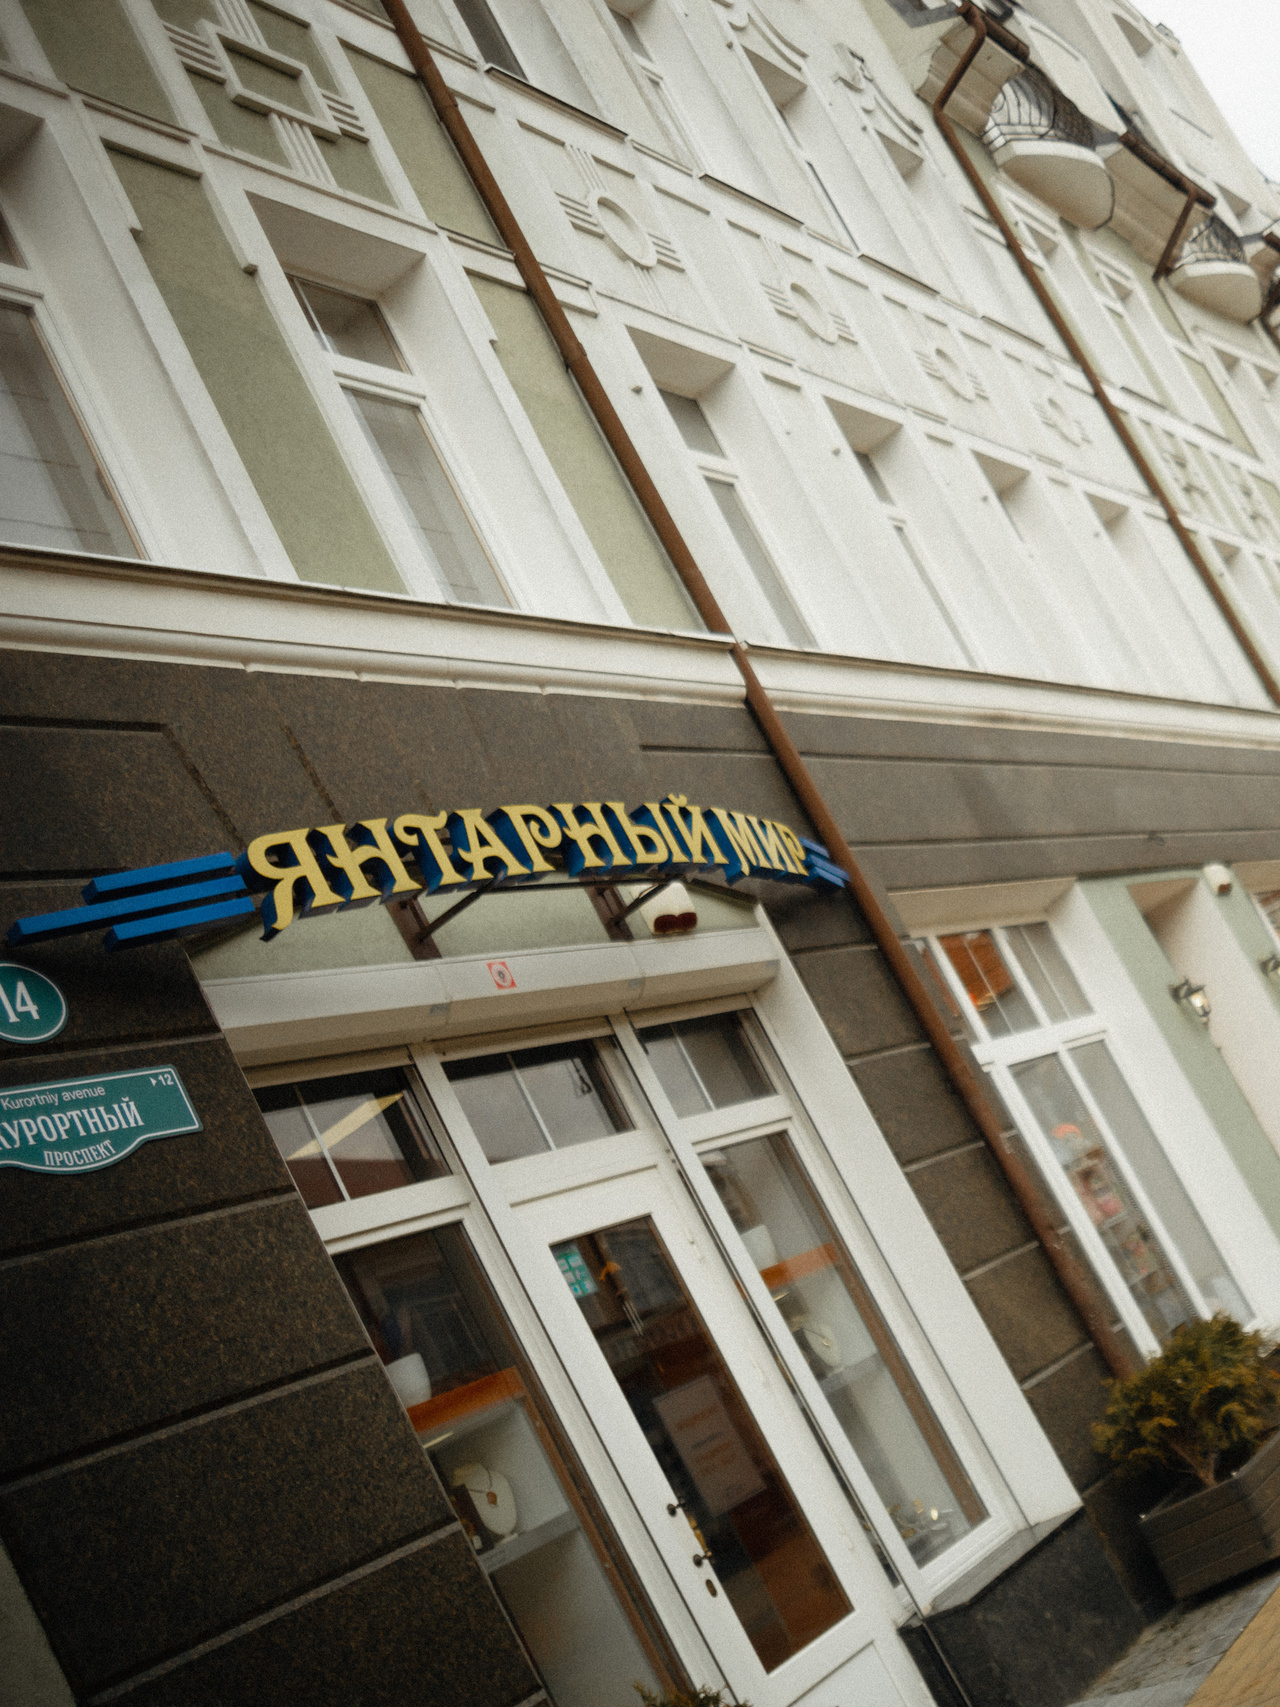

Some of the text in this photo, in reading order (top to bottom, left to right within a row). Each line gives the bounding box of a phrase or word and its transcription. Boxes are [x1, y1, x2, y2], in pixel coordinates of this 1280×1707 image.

[247, 794, 810, 931] ЯНТАРНЫЙ МИР
[0, 981, 40, 1022] 14
[159, 1074, 174, 1086] 12
[1, 1086, 106, 1110] Kurortniy avenue
[43, 1139, 116, 1165] ПРОСПЕКТ
